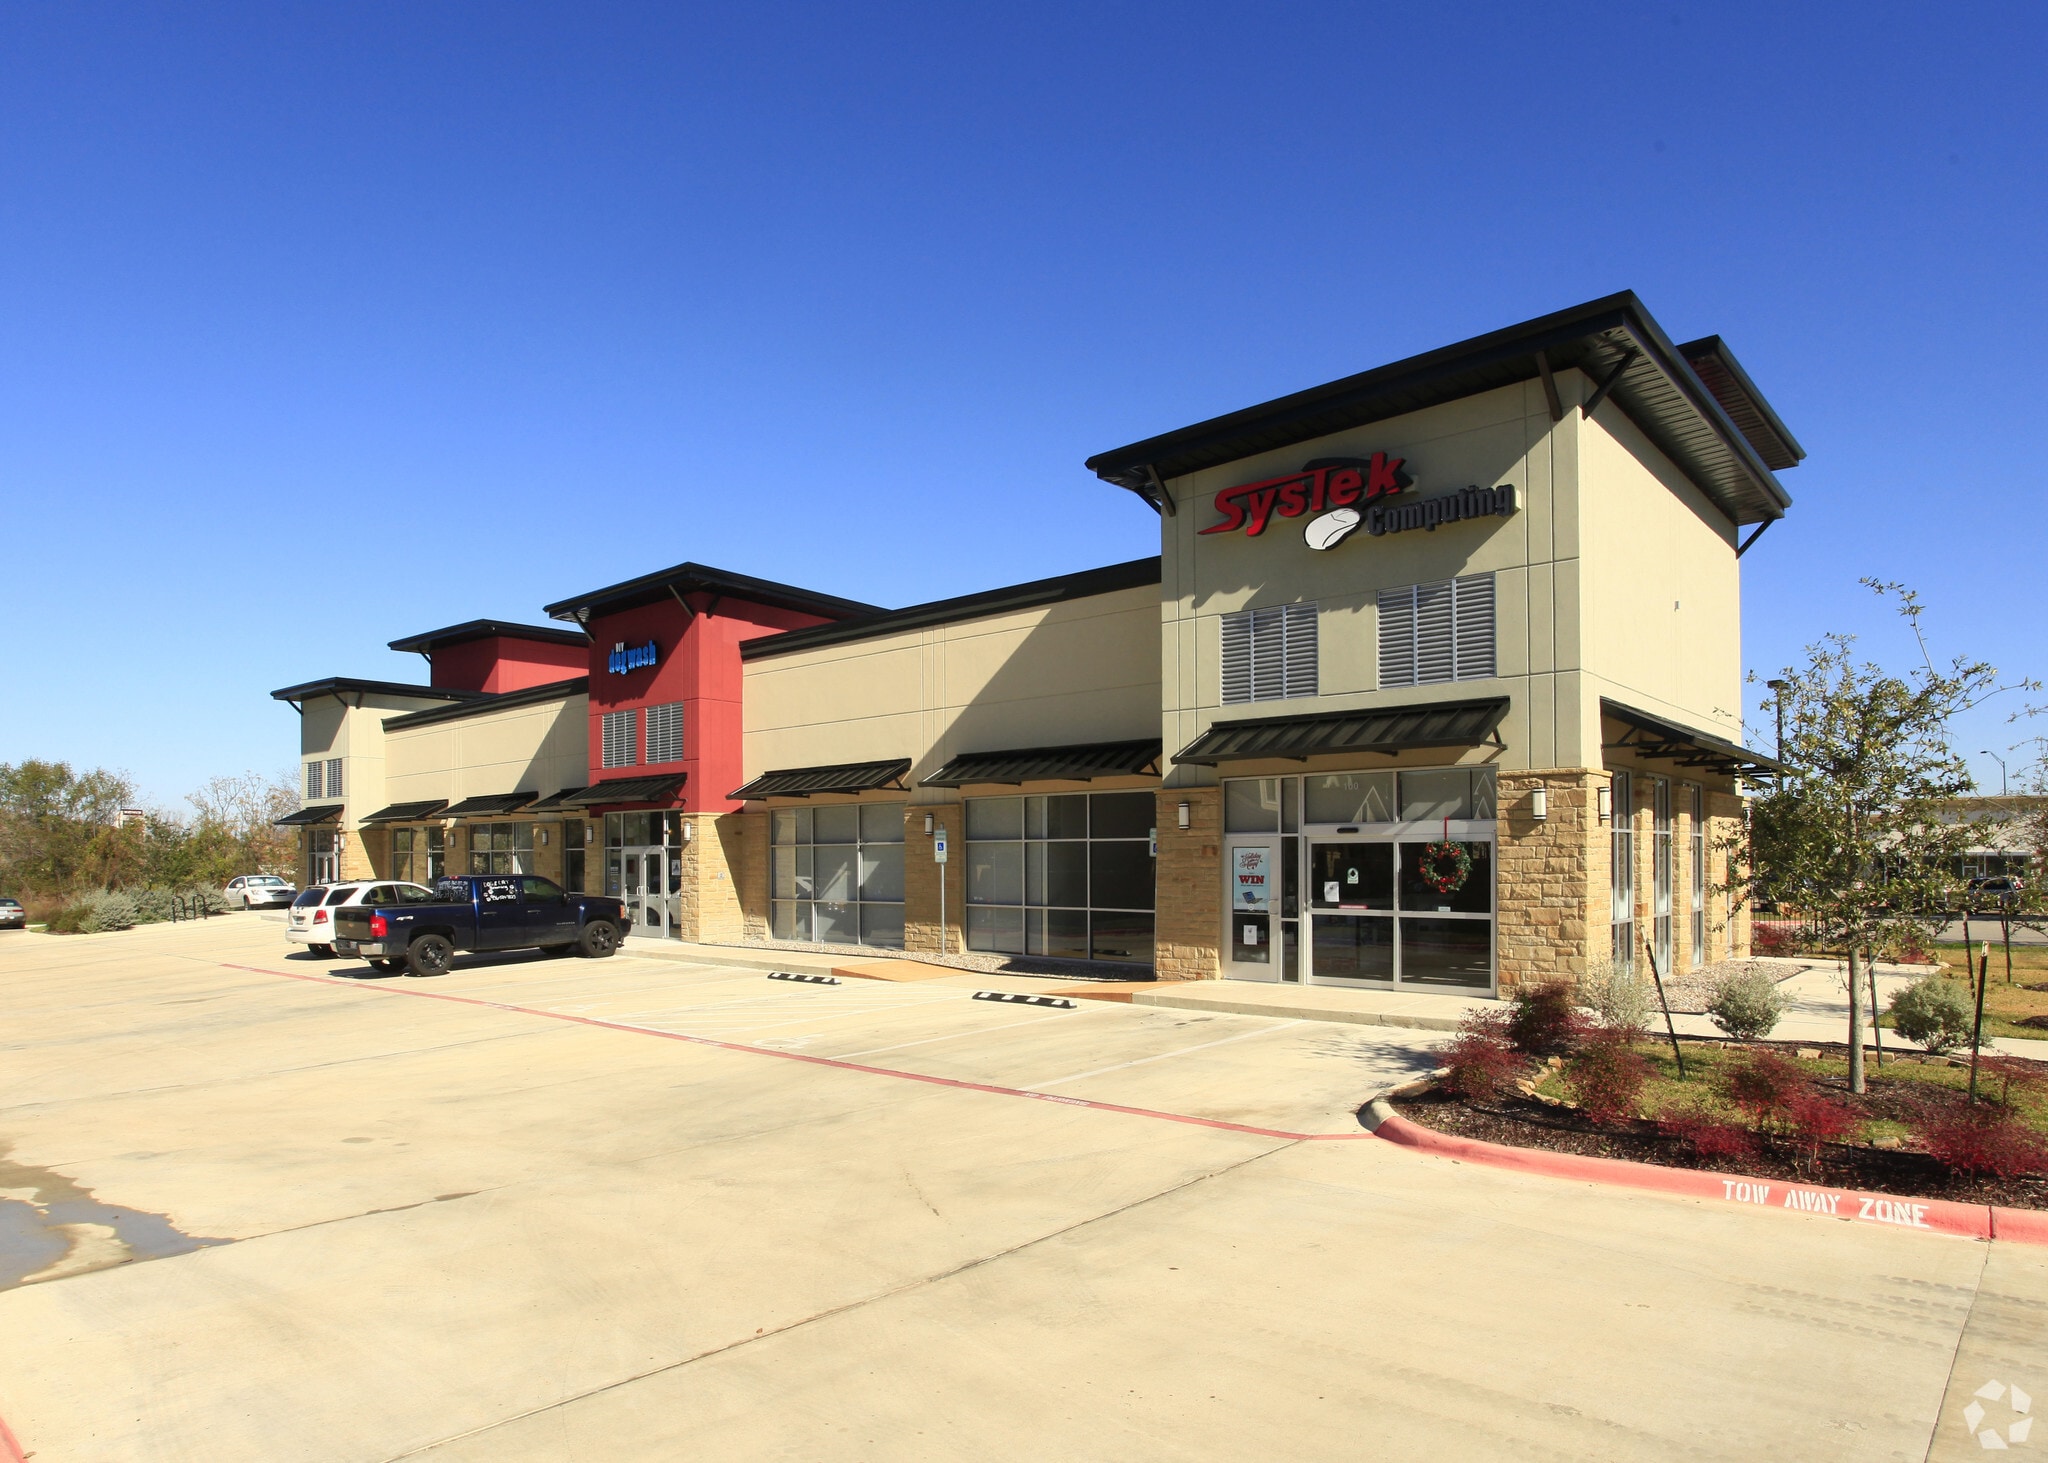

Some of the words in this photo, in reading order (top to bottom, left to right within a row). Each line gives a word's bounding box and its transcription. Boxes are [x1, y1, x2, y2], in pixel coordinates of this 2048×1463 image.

[1367, 483, 1516, 537] Computing
[609, 649, 627, 675] dog
[628, 640, 656, 669] wash
[1239, 875, 1264, 884] WIN
[1722, 1179, 1770, 1205] TOW
[1784, 1189, 1841, 1215] AWAY
[1858, 1197, 1931, 1229] ZONE
